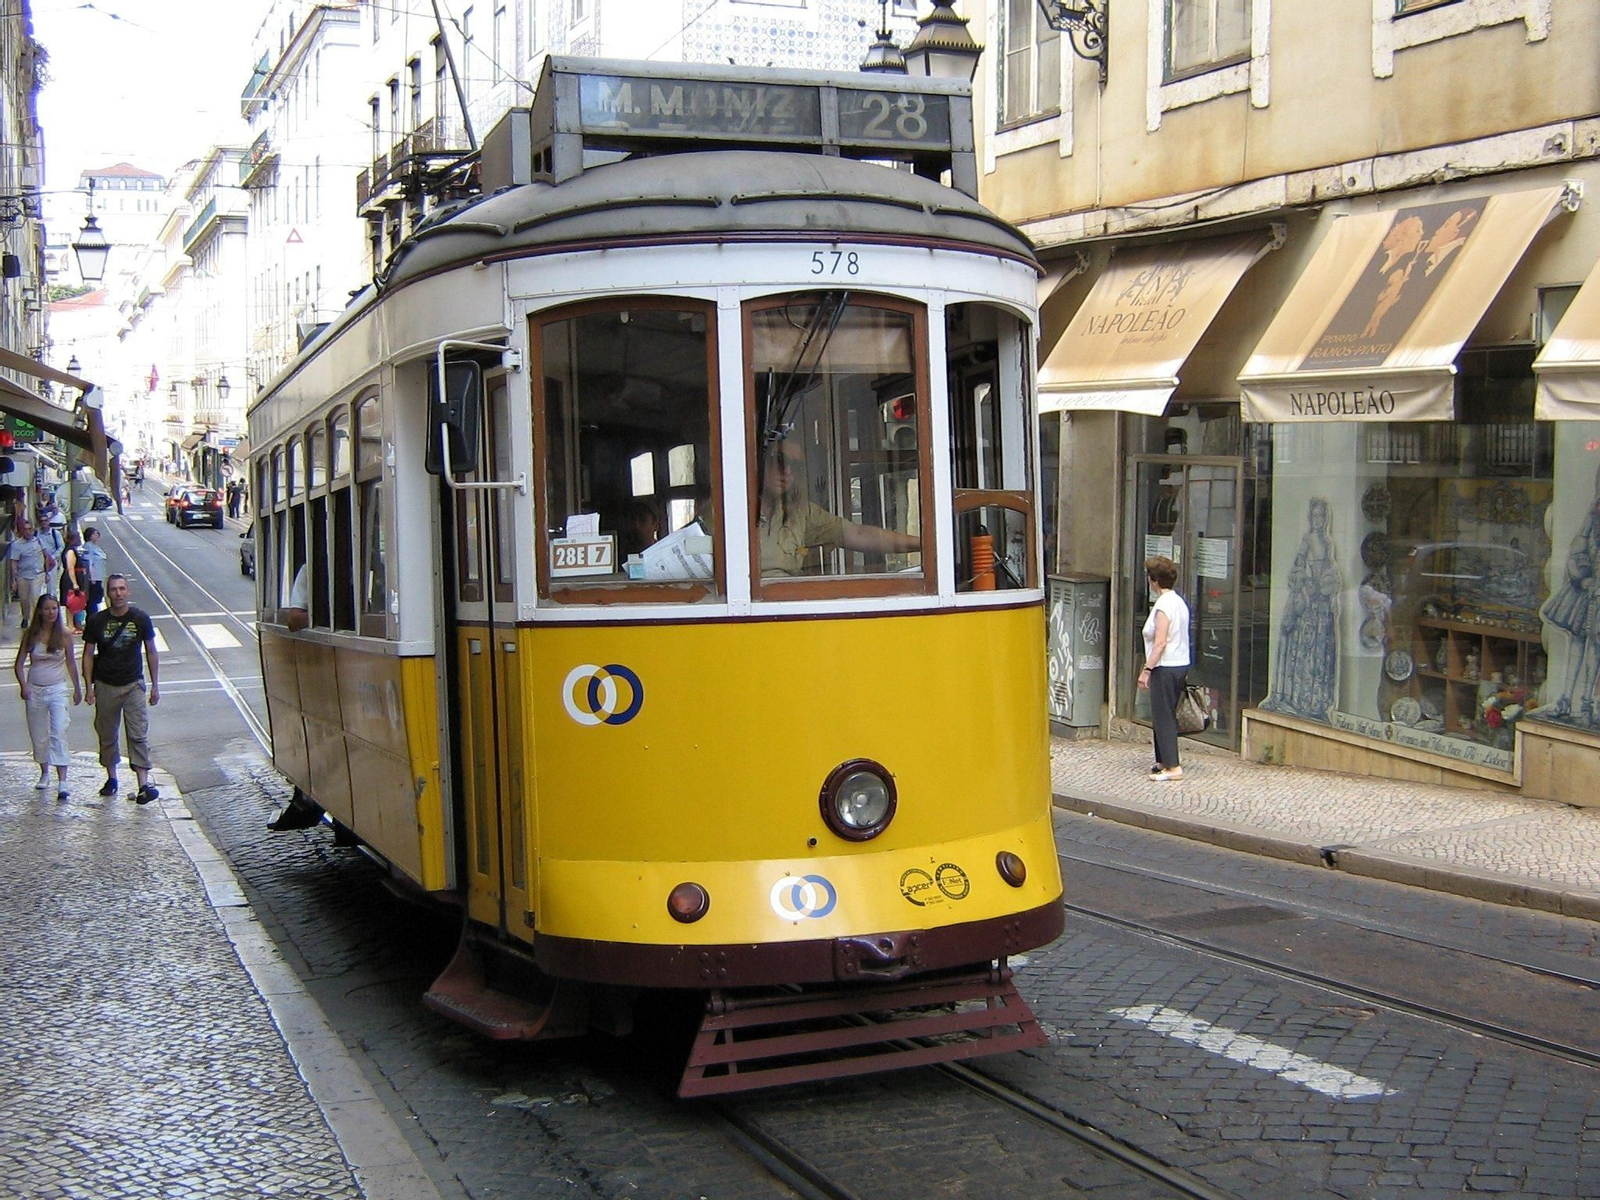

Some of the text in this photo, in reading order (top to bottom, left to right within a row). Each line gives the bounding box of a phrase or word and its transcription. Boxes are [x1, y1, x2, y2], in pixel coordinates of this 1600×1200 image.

[862, 93, 928, 140] 28
[811, 251, 859, 275] 578
[1081, 304, 1185, 336] NAPOLEÃO
[1322, 333, 1357, 344] PORTO
[1290, 386, 1395, 416] NAPOLEÃO
[556, 546, 606, 566] 28E 7
